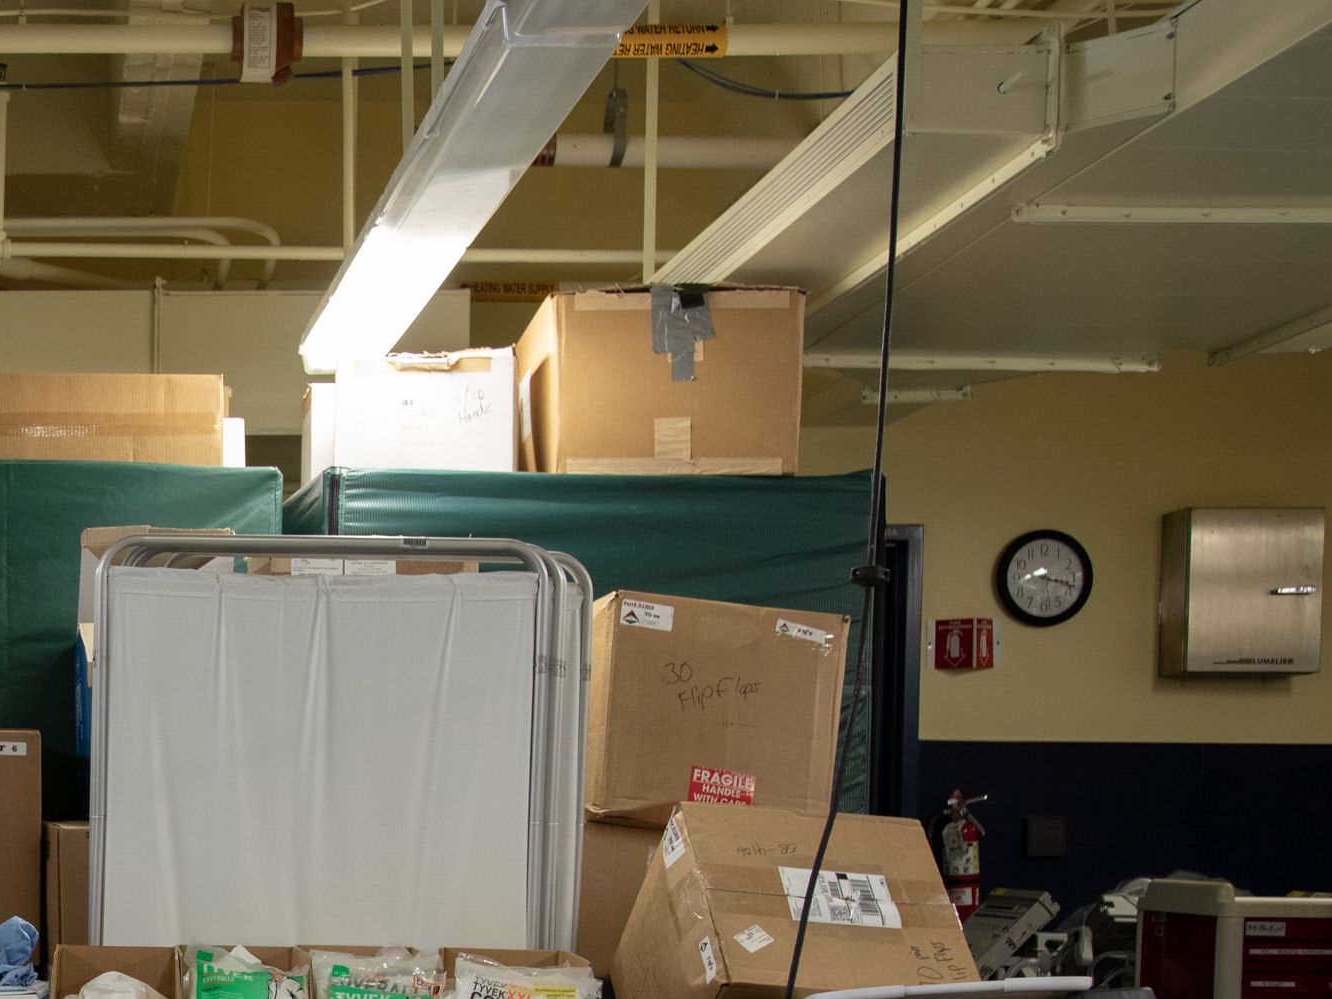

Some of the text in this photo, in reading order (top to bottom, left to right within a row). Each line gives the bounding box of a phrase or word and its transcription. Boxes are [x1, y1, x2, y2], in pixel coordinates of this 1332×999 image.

[637, 25, 705, 35] WATER RETURN
[633, 43, 705, 56] HEATING WATER
[471, 283, 555, 294] HEATING WATER SUPPLY
[1027, 549, 1034, 560] 11
[1040, 544, 1049, 557] 12
[1016, 559, 1026, 570] 10
[1066, 559, 1072, 571] 2
[1016, 588, 1024, 599] 8
[1027, 597, 1034, 608] 7
[1040, 602, 1048, 612] 6
[1054, 597, 1062, 608] 5
[665, 662, 693, 685] 30
[693, 769, 753, 790] FRAGILE
[702, 784, 741, 798] HANDLE
[693, 793, 717, 804] WITH
[203, 975, 235, 984] COVERALLS
[473, 981, 507, 999] TYVEK
